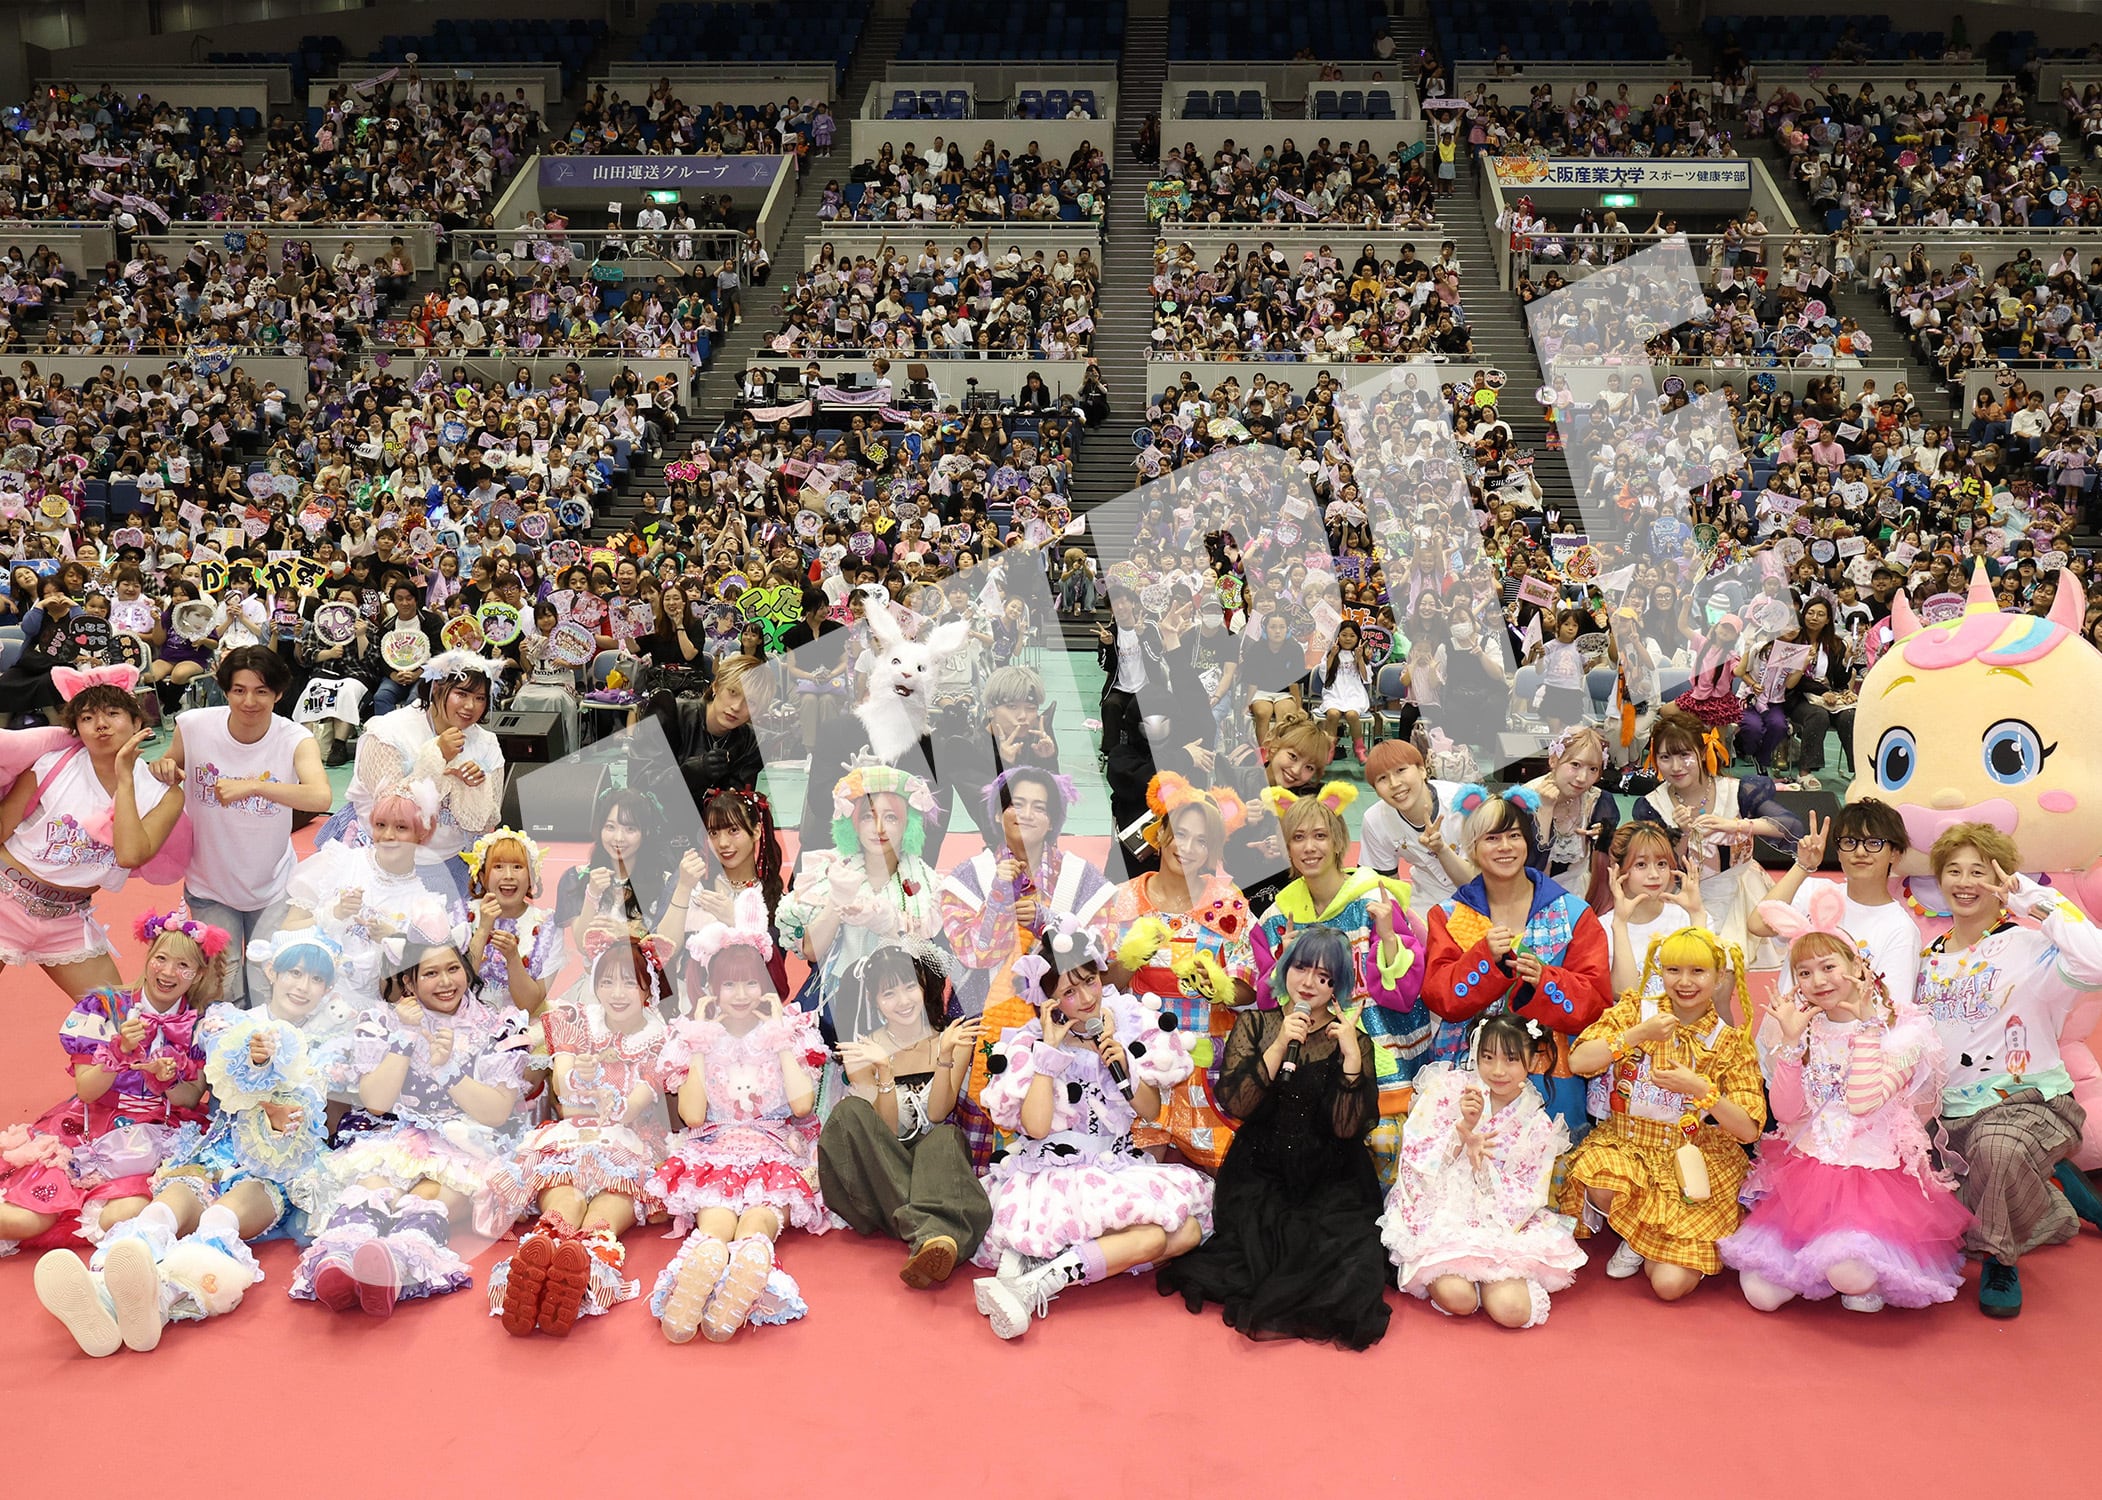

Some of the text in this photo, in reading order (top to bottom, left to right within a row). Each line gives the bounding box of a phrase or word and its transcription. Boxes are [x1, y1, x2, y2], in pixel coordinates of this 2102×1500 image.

[593, 164, 730, 180] 山田運送グループ
[1540, 166, 1747, 184] 大阪産業大学 スポーツ健康学部
[5, 867, 60, 901] Calvin
